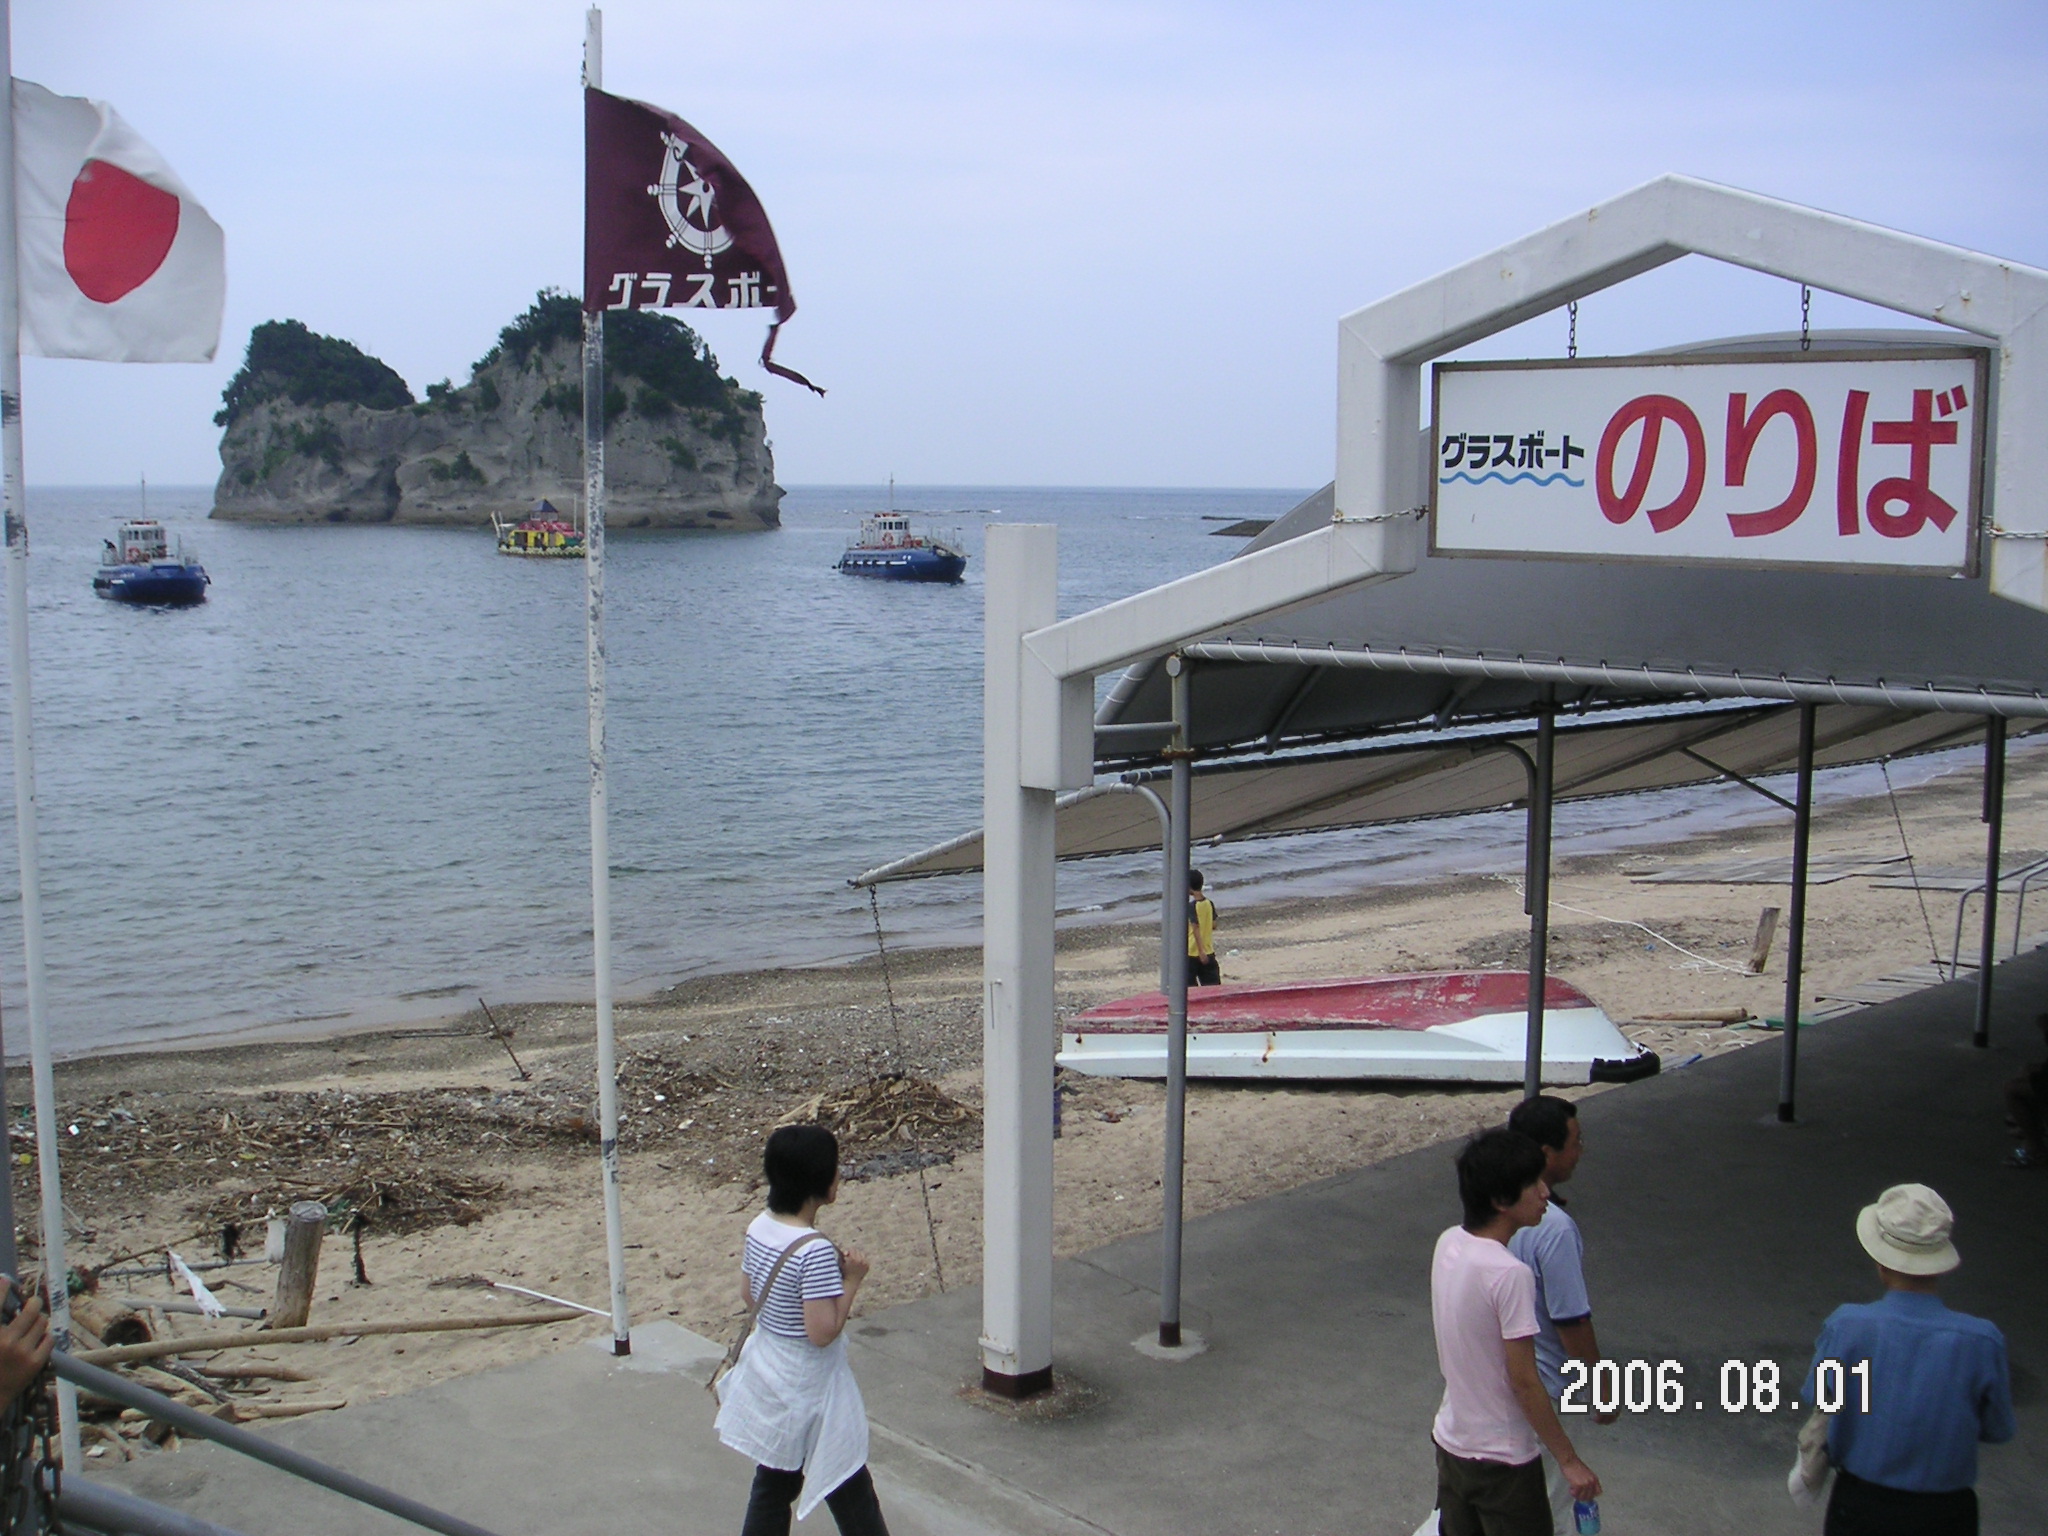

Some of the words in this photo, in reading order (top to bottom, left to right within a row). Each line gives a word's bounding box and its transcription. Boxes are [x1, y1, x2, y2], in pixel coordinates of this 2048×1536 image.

[1440, 430, 1585, 470] グラスボート
[1595, 384, 1968, 538] のりば
